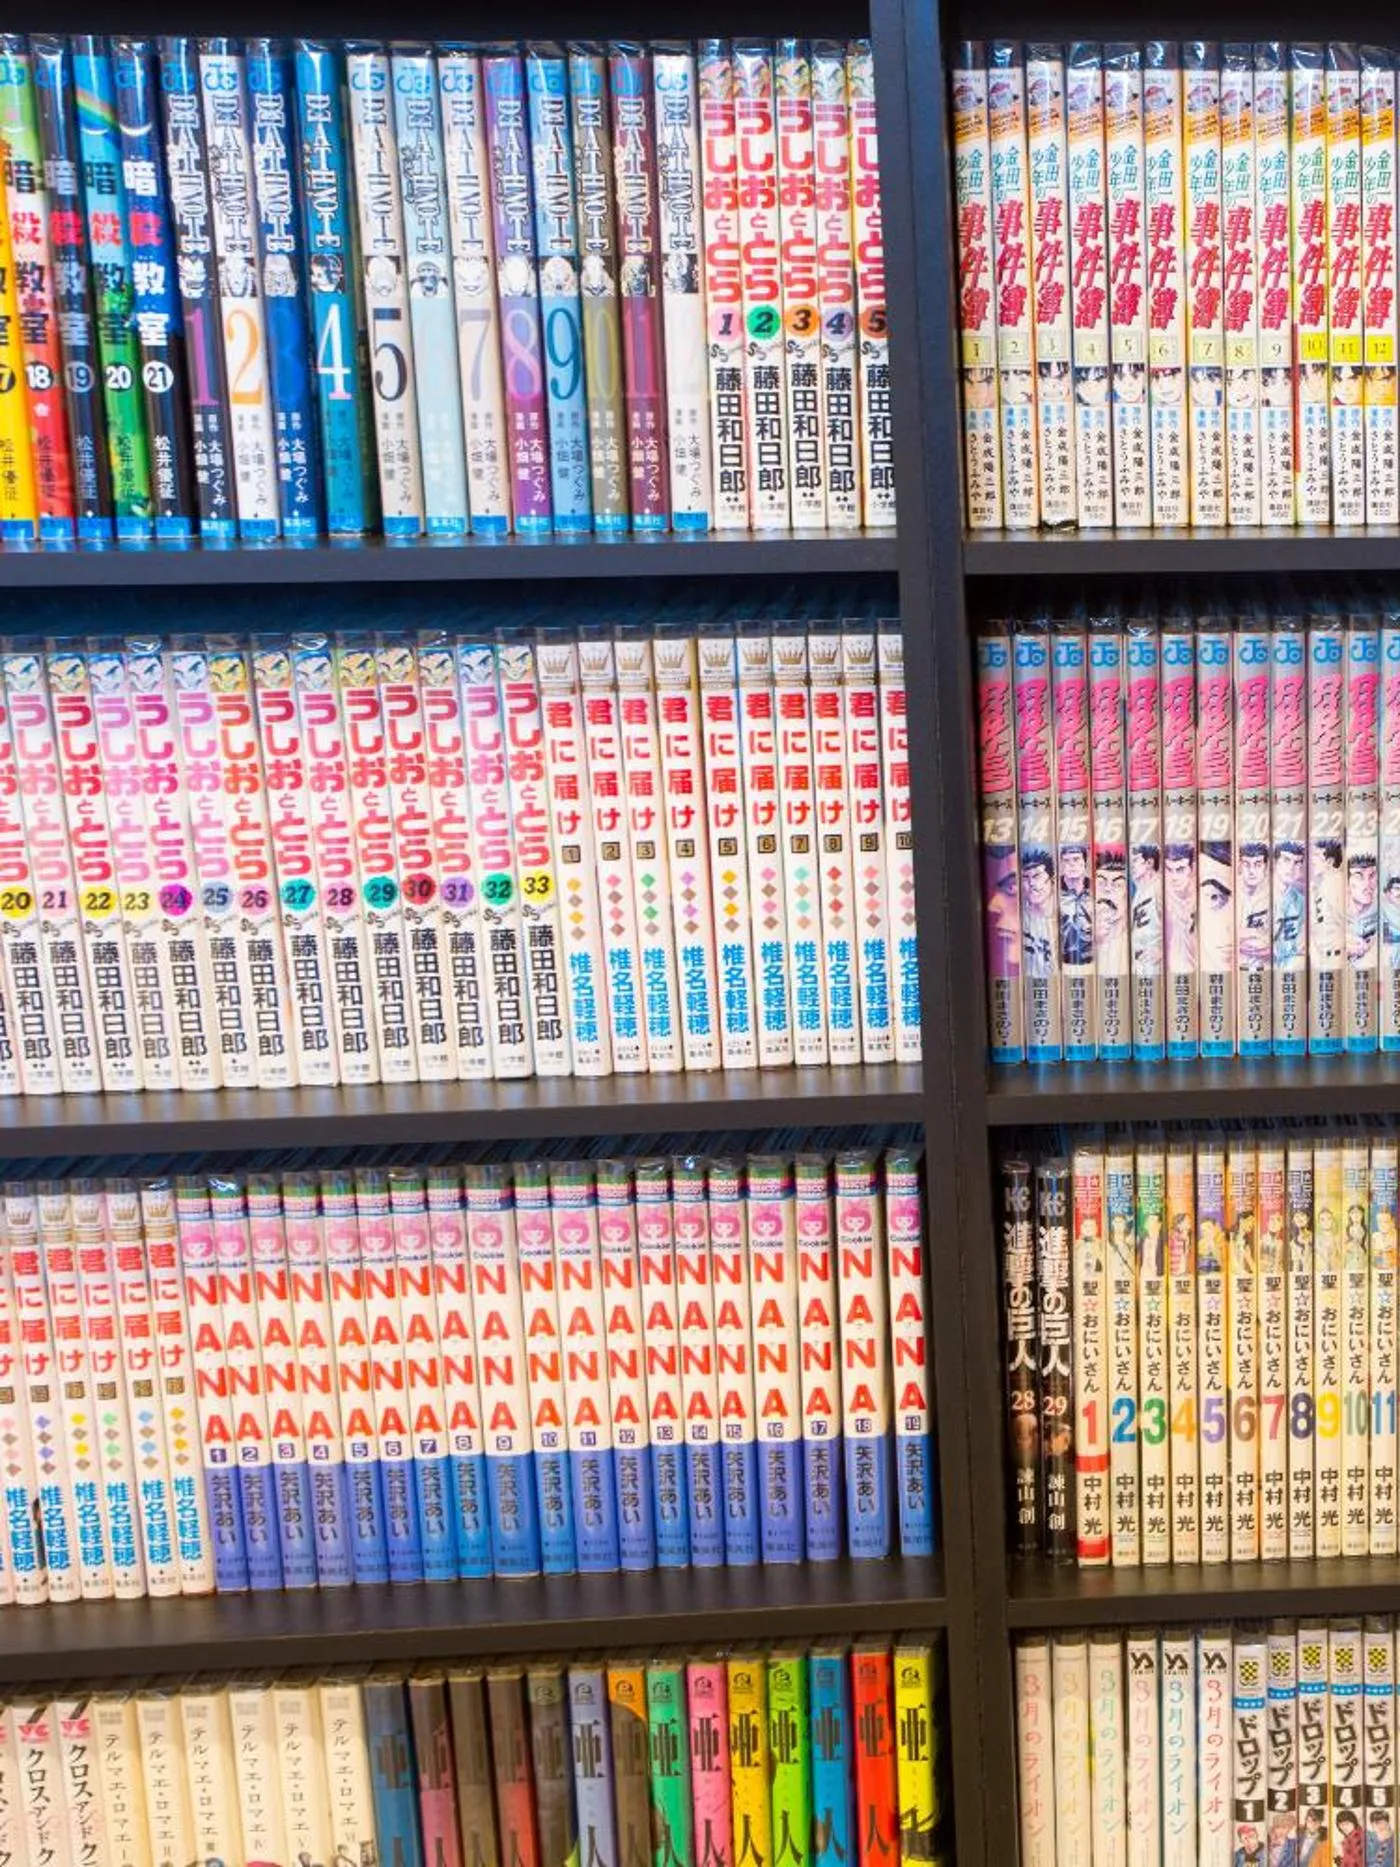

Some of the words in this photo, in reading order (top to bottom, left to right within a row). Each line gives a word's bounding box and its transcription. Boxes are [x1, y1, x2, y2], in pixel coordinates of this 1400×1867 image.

[703, 100, 741, 303] うしおととら
[777, 98, 818, 299] うしおととら
[815, 101, 852, 303] うしおととら
[959, 202, 989, 331] 事件簿
[1110, 200, 1142, 329] 事件簿
[1259, 203, 1289, 331] 事件簿
[226, 308, 263, 405] 2
[317, 302, 352, 400] 4
[373, 307, 407, 401] 5
[507, 308, 539, 399] 8
[547, 307, 579, 401] 9
[718, 312, 732, 334] 1
[755, 312, 773, 333] 2
[793, 308, 811, 331] 3
[1271, 342, 1282, 357] 9
[1306, 339, 1322, 354] 10
[1372, 342, 1388, 357] 12
[26, 363, 52, 389] 18
[67, 364, 90, 389] 19
[106, 365, 132, 389] 20
[146, 364, 171, 389] 21
[715, 366, 746, 494] 藤田和日郎
[753, 365, 785, 493] 藤田和日郎
[790, 363, 822, 489] 藤田和日郎
[57, 695, 112, 882] うしおととら
[135, 694, 188, 880] うしおととら
[260, 691, 311, 876] うしおととら
[505, 683, 550, 866] うしおととら
[546, 702, 581, 835] 君に届け
[661, 697, 695, 828] 君に届け
[745, 693, 776, 824] 君に届け
[850, 692, 879, 824] 君に届け
[85, 891, 112, 910] 22
[284, 885, 311, 903] 27
[406, 878, 431, 896] 30
[525, 877, 550, 894] 33
[10, 942, 52, 1059] 藤田和日郎
[292, 934, 329, 1051] 藤田和日郎
[569, 953, 598, 1042] 椎名軽穂
[723, 944, 750, 1033] 椎名軽穂
[863, 939, 889, 1028] 椎名軽穂
[151, 1243, 184, 1369] 君に届け
[522, 1262, 561, 1427] NANA
[754, 1253, 788, 1416] NANA
[893, 1248, 927, 1411] NANA
[1039, 1226, 1069, 1377] 進撃の巨人
[186, 1274, 232, 1443] NANA
[257, 1269, 300, 1437] NANA
[399, 1266, 442, 1432] NANA
[1012, 1390, 1035, 1412] 28
[1044, 1397, 1067, 1417] 29
[1081, 1401, 1098, 1444] 1
[1112, 1400, 1137, 1442] 2
[1203, 1397, 1225, 1443] 5
[1291, 1394, 1315, 1438] 8
[211, 1476, 237, 1544] 矢沢あい
[314, 1473, 337, 1540] 矢沢あい
[657, 1452, 677, 1520] 矢沢あい
[856, 1445, 875, 1514] 矢沢あい
[105, 1734, 131, 1844] テルマエ・ロマエ
[333, 1718, 358, 1827] テルマエ・ロマエ
[1205, 1680, 1225, 1834] 3月のライオン
[1236, 1714, 1257, 1796] ドロップ
[1335, 1703, 1358, 1781] ドロップ
[1244, 1800, 1255, 1821] 1
[1340, 1788, 1353, 1807] 4
